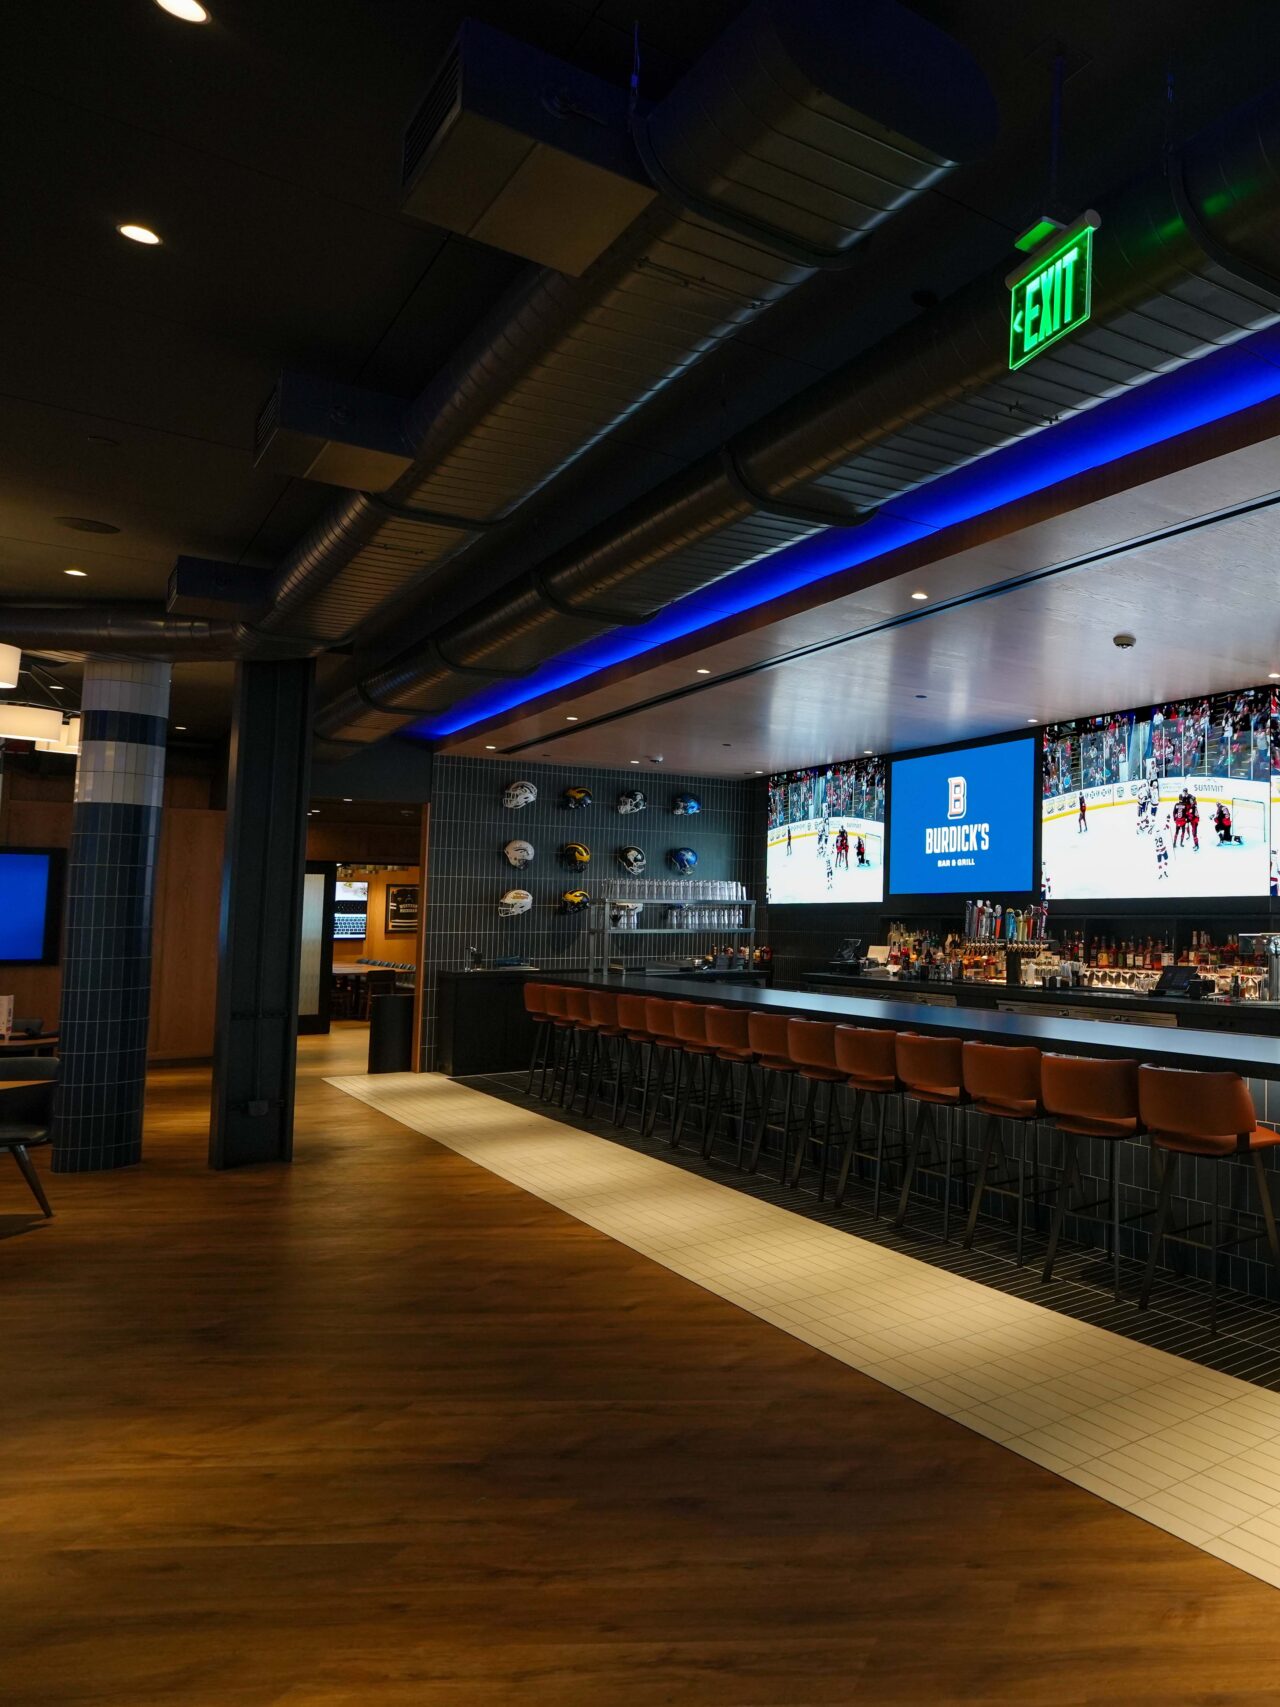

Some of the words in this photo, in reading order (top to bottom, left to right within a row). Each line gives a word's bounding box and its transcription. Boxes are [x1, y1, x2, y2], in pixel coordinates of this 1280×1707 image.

[1024, 247, 1079, 352] EXIT
[925, 822, 989, 854] BURDICK'S
[957, 858, 975, 866] GRILL
